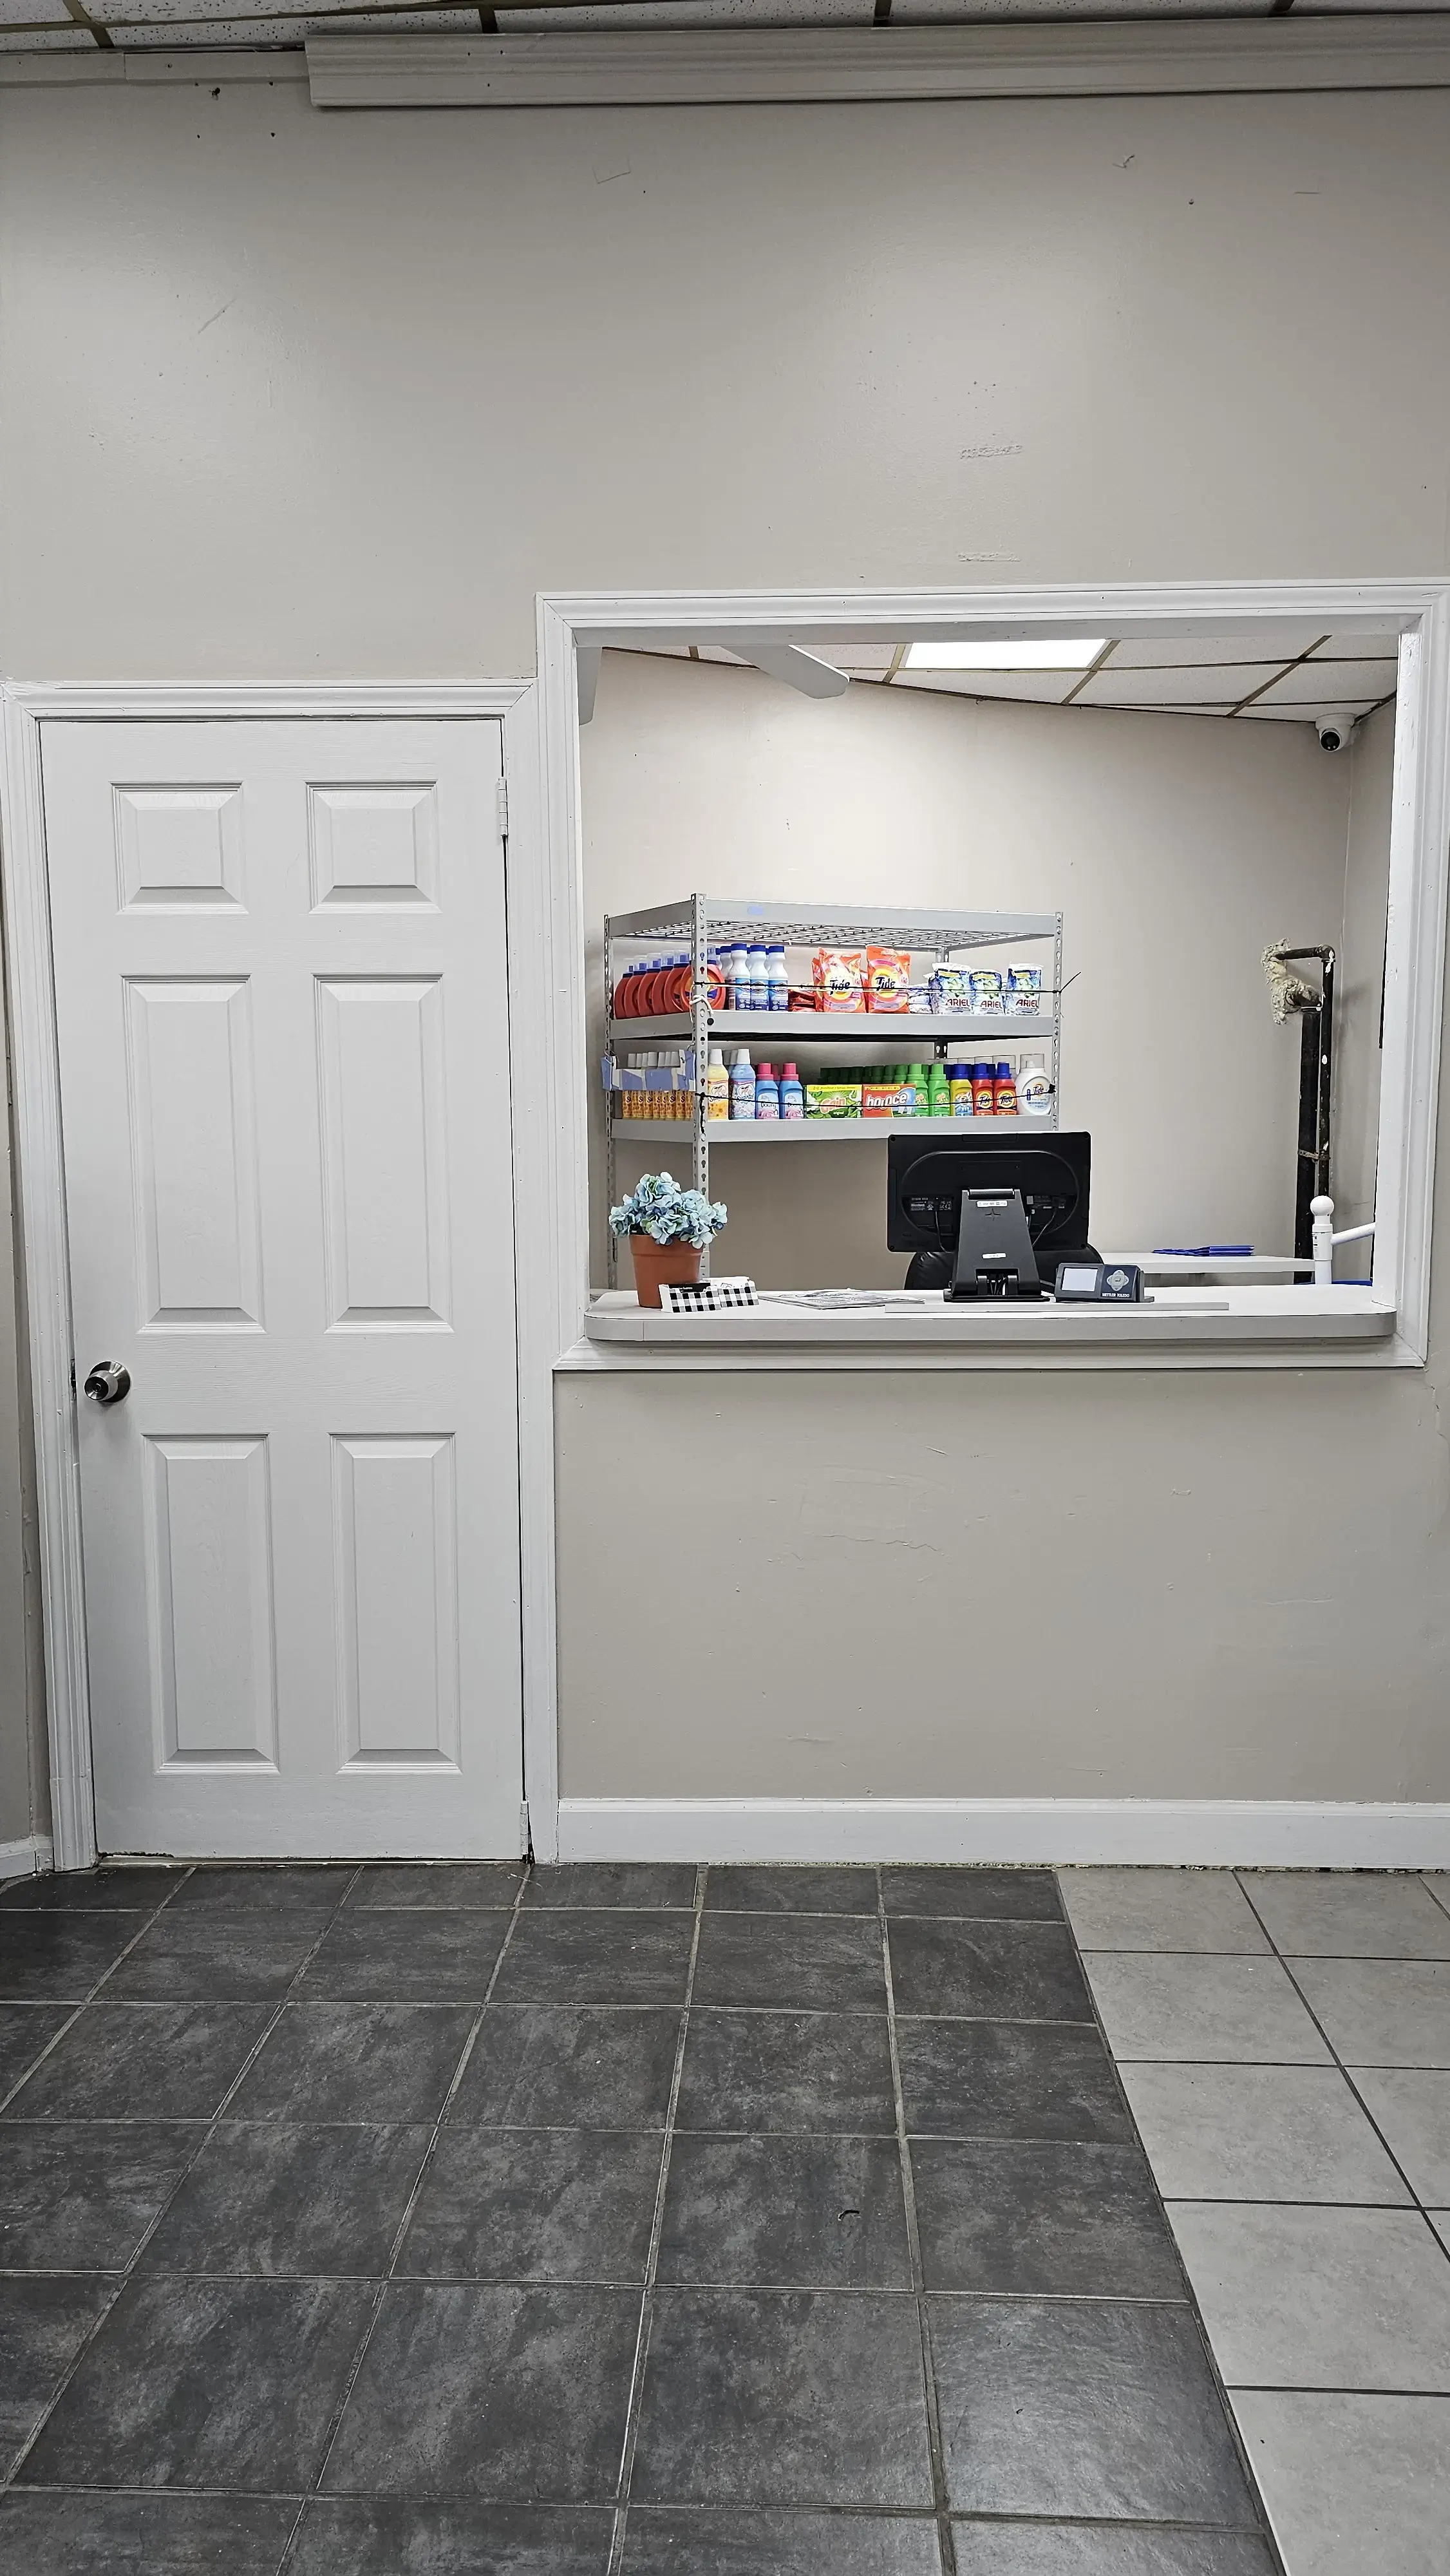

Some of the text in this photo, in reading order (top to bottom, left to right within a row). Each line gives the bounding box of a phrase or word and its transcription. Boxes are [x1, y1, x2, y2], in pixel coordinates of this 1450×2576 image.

[830, 980, 851, 995] Tide
[875, 976, 896, 991] Tide
[946, 998, 970, 1007] ARIEL
[981, 1000, 1003, 1009] ARIEL
[1015, 999, 1039, 1007] ARIEL
[1033, 1086, 1044, 1095] Tide
[821, 1097, 847, 1113] Gain
[867, 1094, 907, 1109] bounce
